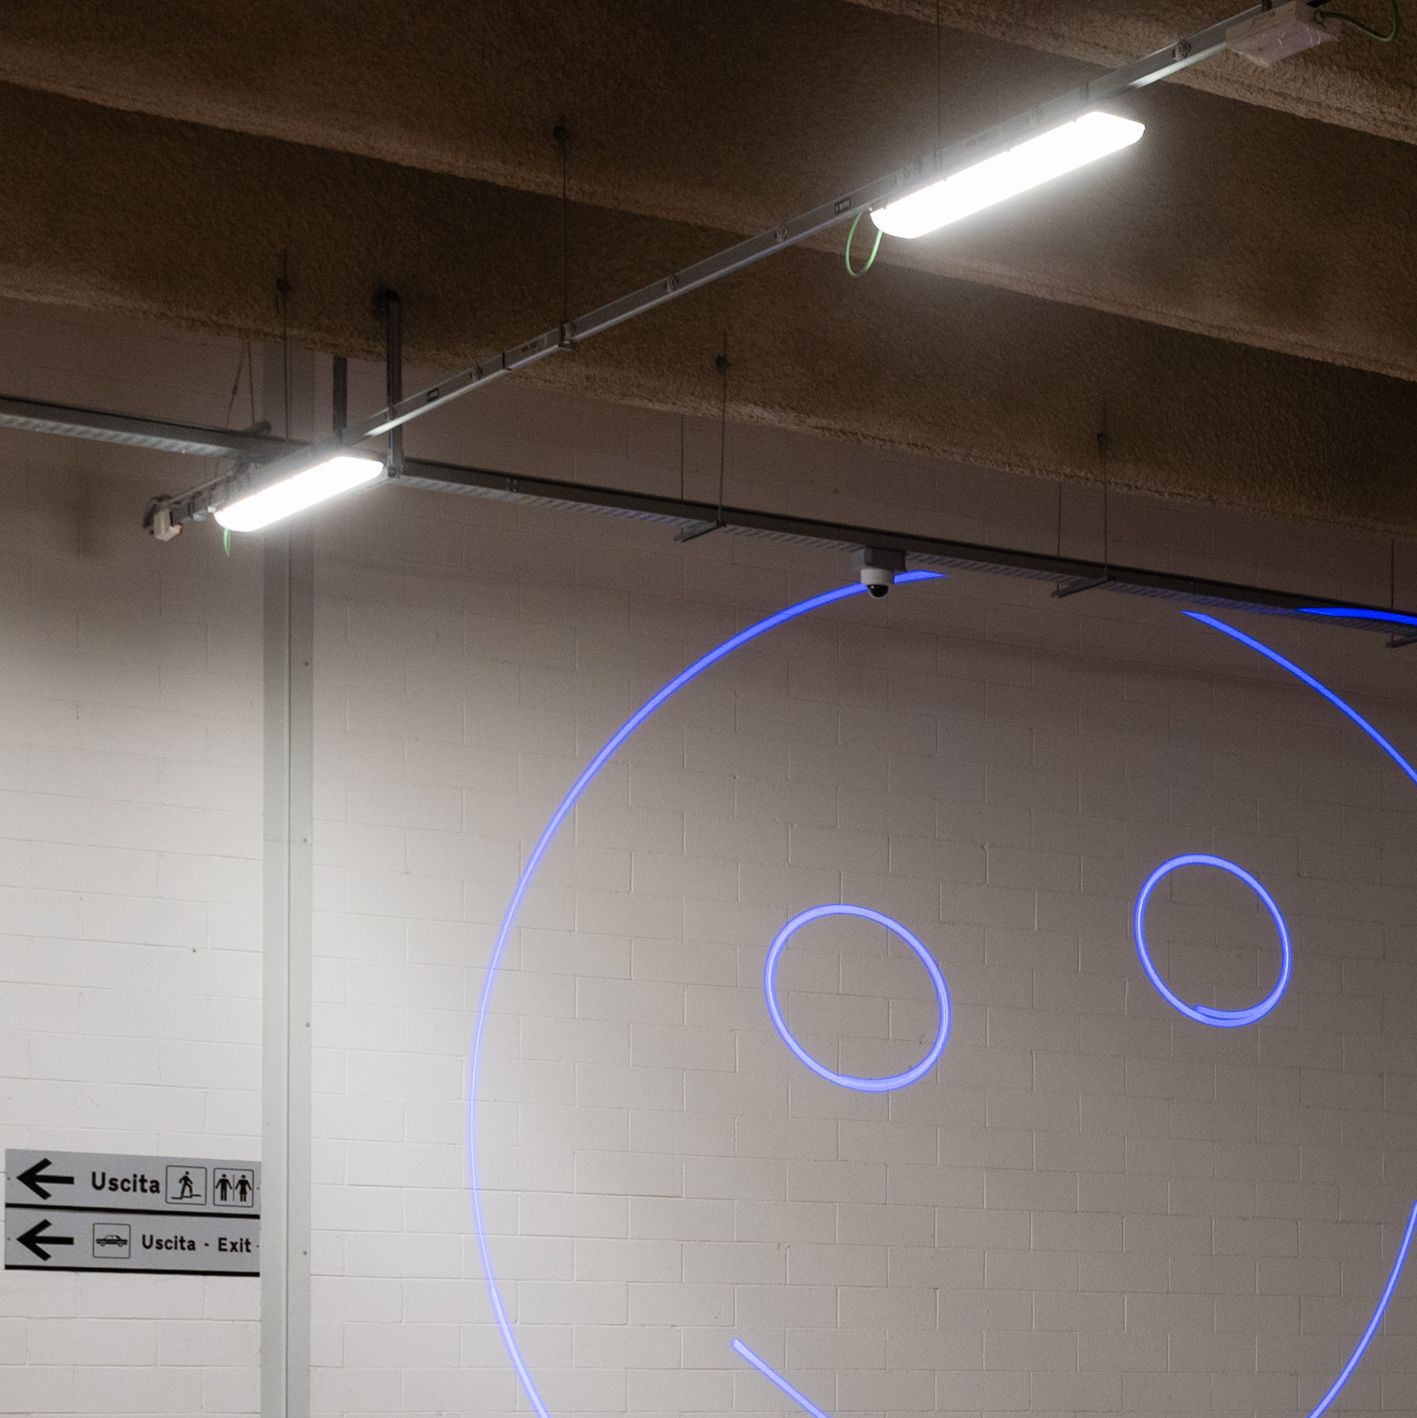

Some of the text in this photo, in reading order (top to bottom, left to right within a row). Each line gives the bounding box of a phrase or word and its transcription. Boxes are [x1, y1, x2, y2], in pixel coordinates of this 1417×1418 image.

[92, 1171, 160, 1194] Uscita
[142, 1234, 196, 1251] Uscita
[218, 1237, 251, 1253] Exit
